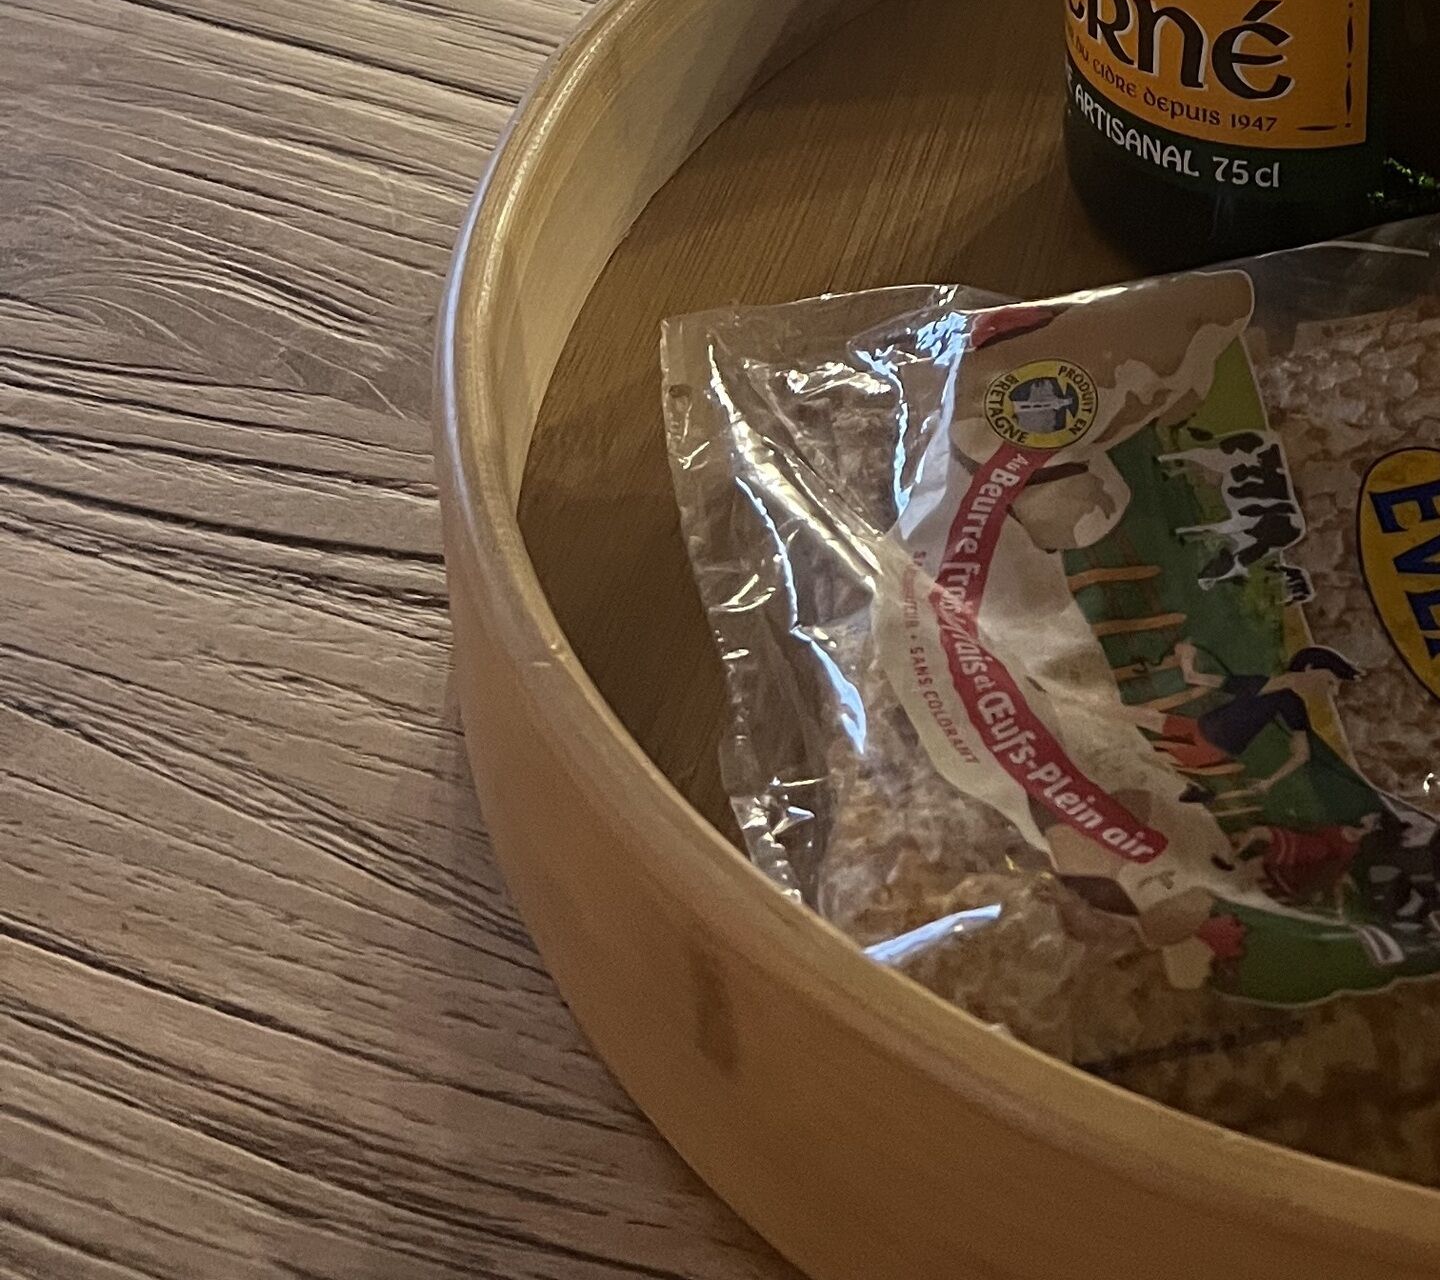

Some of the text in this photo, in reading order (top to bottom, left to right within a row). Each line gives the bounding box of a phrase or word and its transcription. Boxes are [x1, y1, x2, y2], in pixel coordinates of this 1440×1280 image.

[1075, 82, 1201, 179] ARTISANAL
[1230, 112, 1279, 133] 1947
[988, 364, 1095, 444] PRODUIT EN BRETAGNE
[909, 646, 934, 687] SANS
[954, 467, 1021, 555] Beurre
[1101, 825, 1156, 857] air
